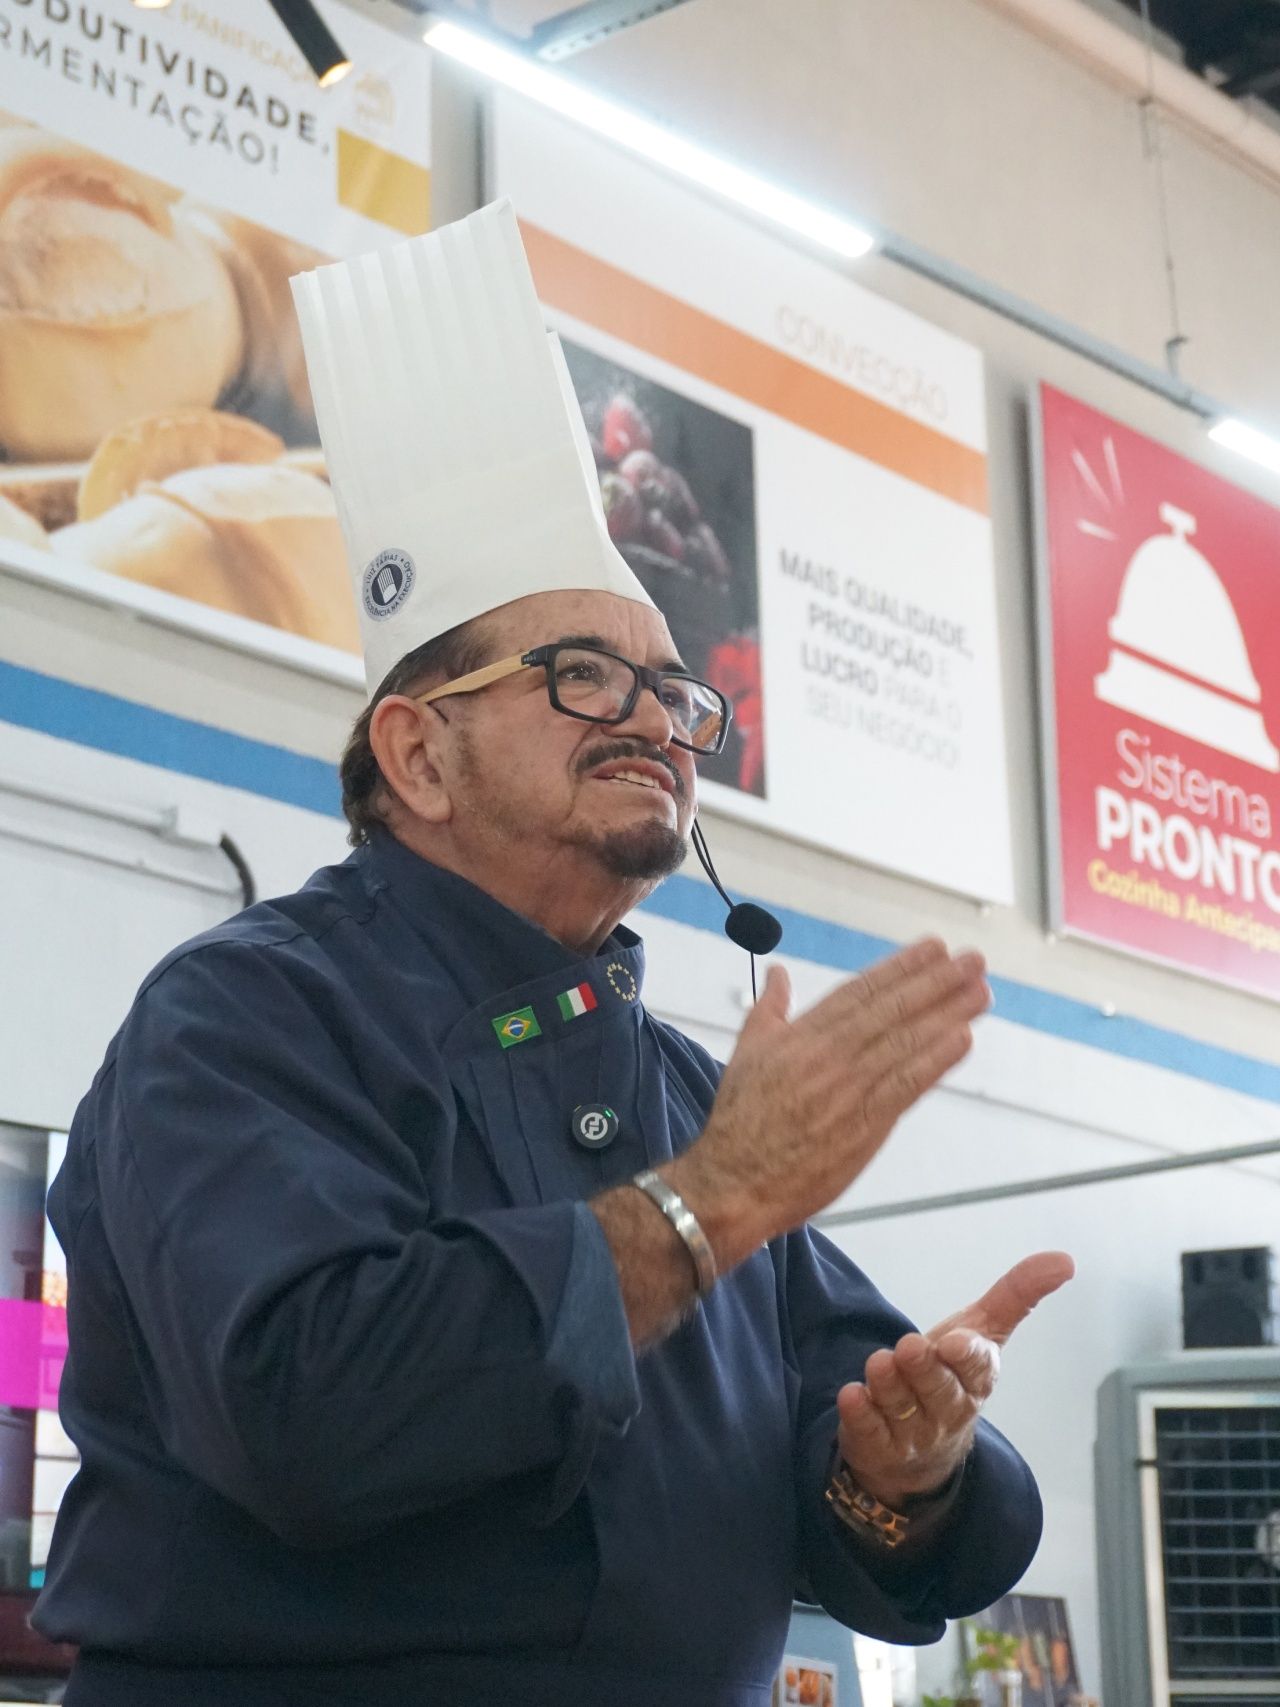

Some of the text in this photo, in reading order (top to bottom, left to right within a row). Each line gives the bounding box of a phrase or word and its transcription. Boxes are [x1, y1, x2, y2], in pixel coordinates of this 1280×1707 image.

[13, 0, 330, 156] DUTIVIDADE,
[776, 304, 948, 420] CONVECÇÃO
[778, 547, 975, 662] MAIS QUALIDADE,
[807, 601, 933, 679] PRODUÇÃO
[799, 640, 963, 732] LUCRO PARA O
[804, 684, 848, 729] SEU
[1116, 728, 1272, 840] Sistema
[1087, 857, 1181, 920] Cozinha
[1095, 784, 1280, 914] PRONTO
